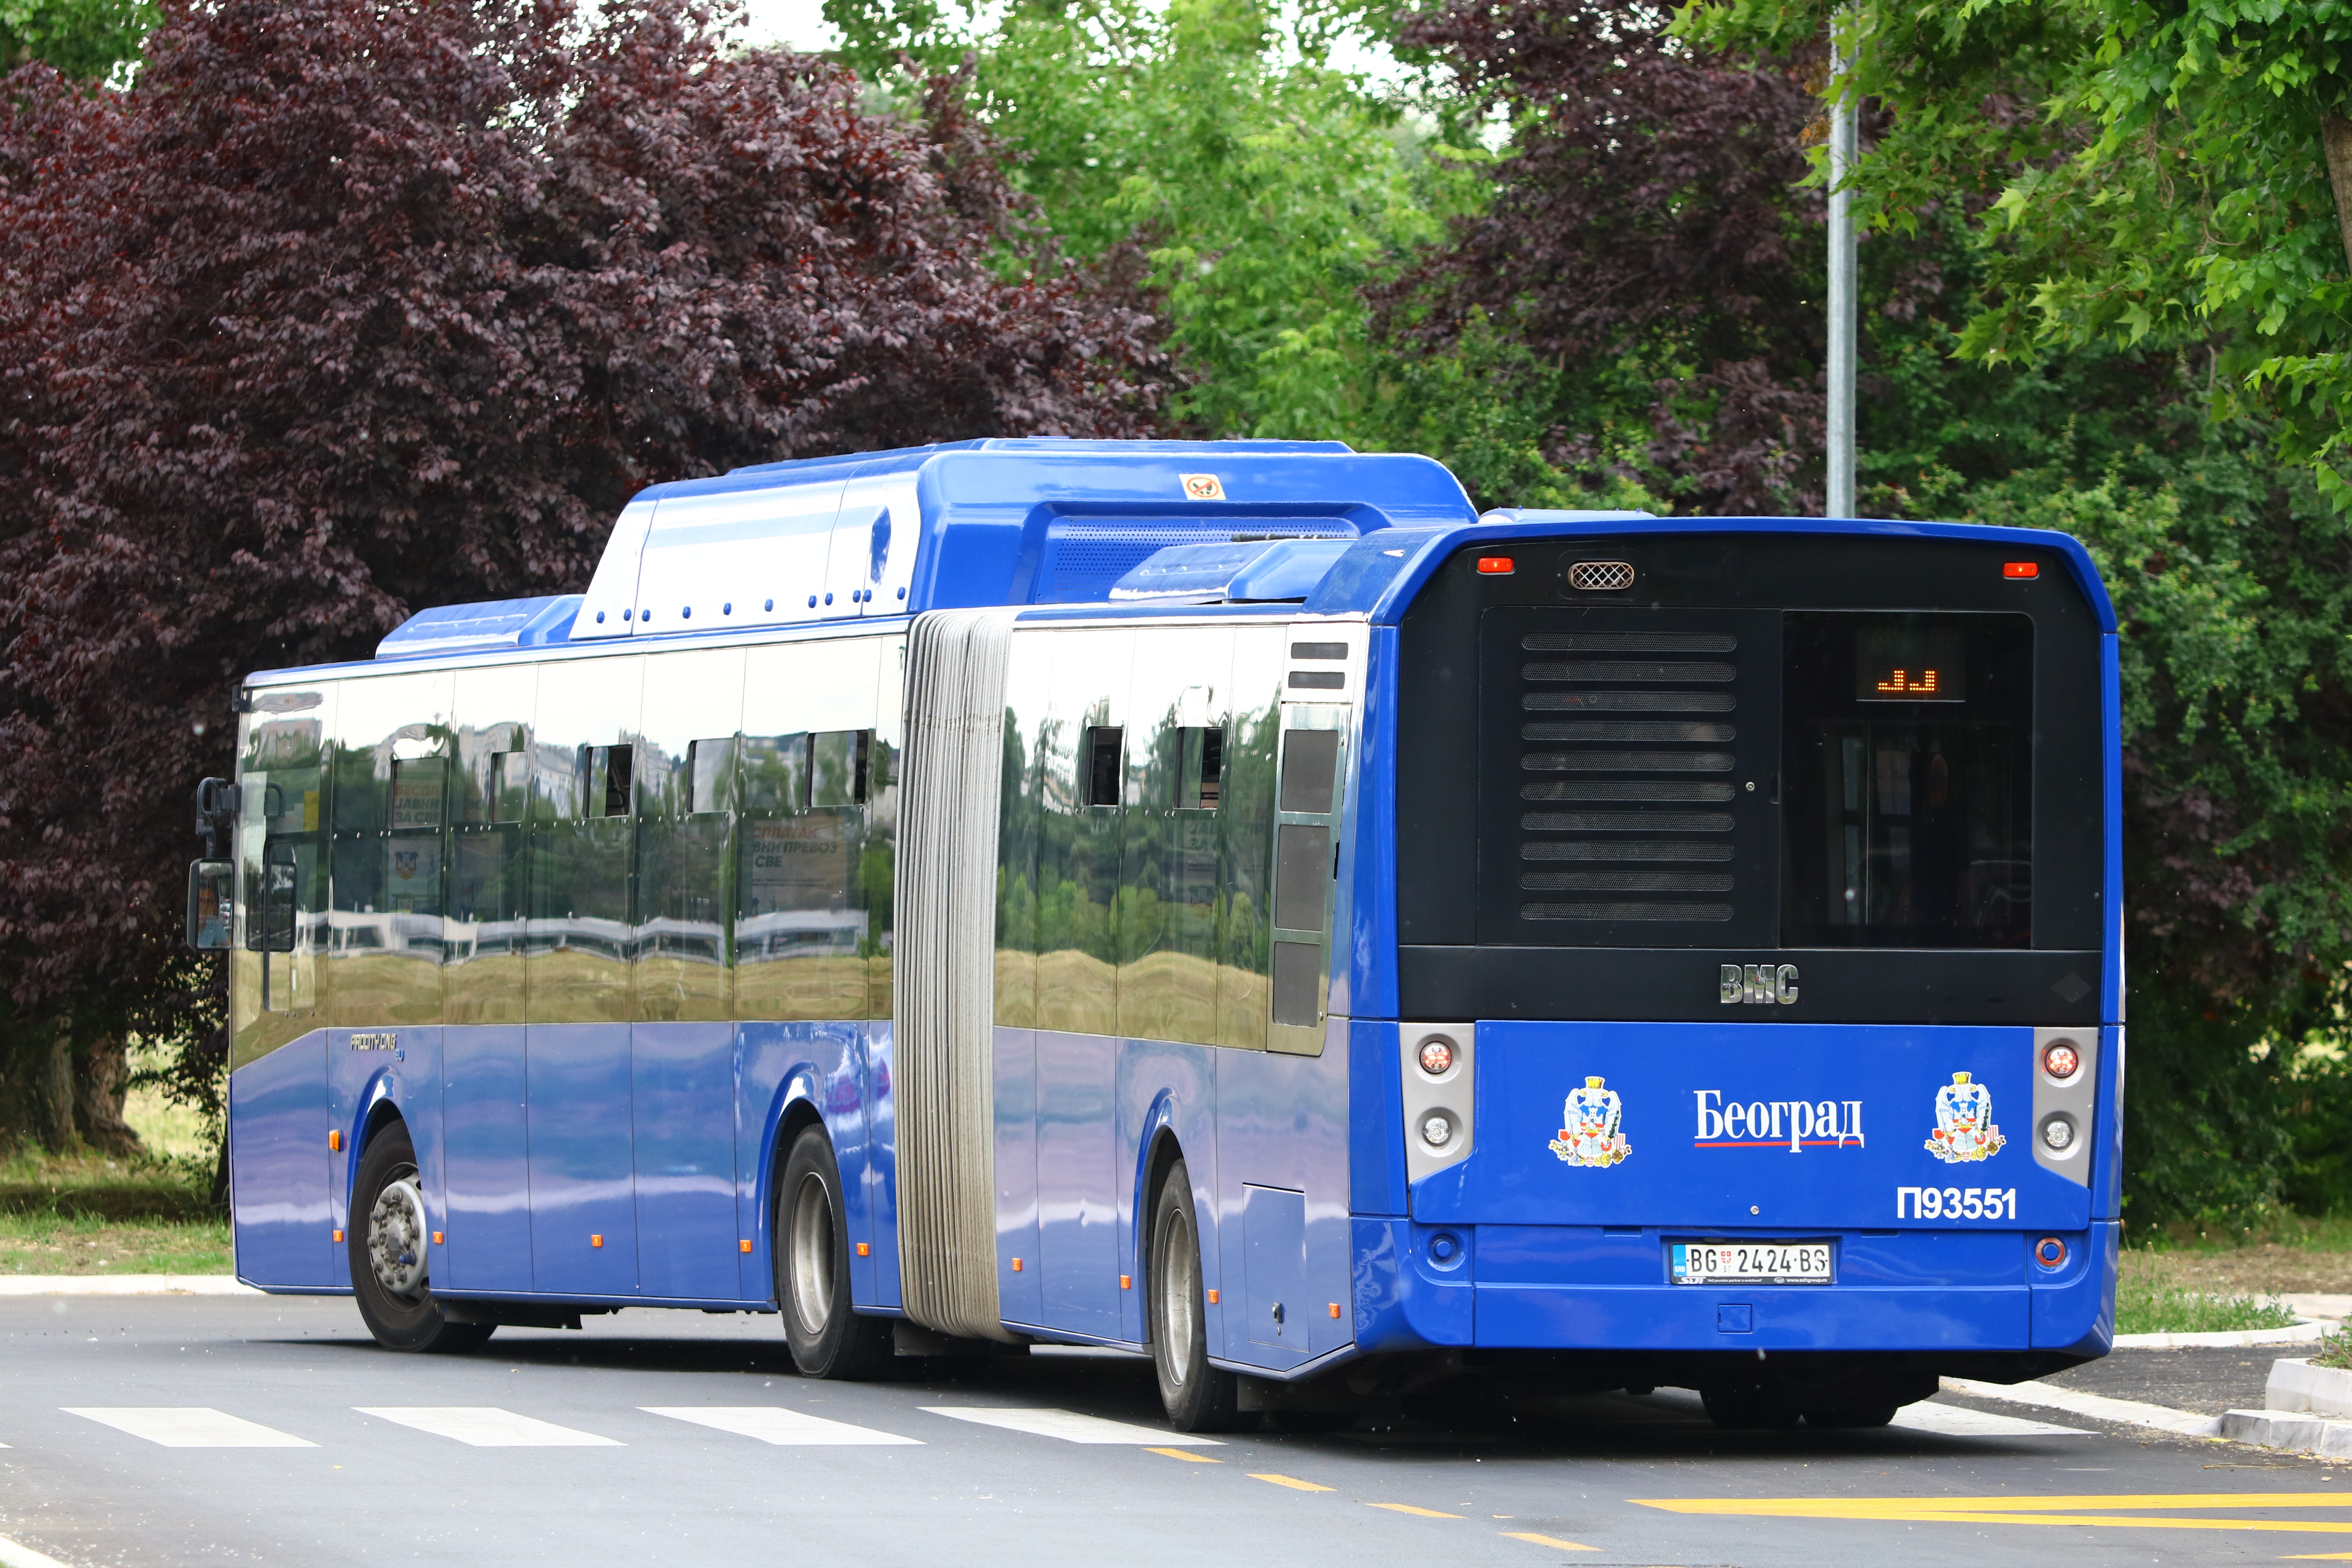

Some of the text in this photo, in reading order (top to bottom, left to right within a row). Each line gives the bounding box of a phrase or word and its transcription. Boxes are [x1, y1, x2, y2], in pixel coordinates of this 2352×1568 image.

[783, 841, 838, 853] ПРЕВОЗ
[755, 855, 782, 867] СВЕ
[1720, 964, 1798, 1005] BMC
[350, 1033, 397, 1050] PROCITY CNG
[1693, 1090, 1864, 1152] Београд
[1897, 1187, 2016, 1219] П93551
[1691, 1249, 1717, 1272] BG
